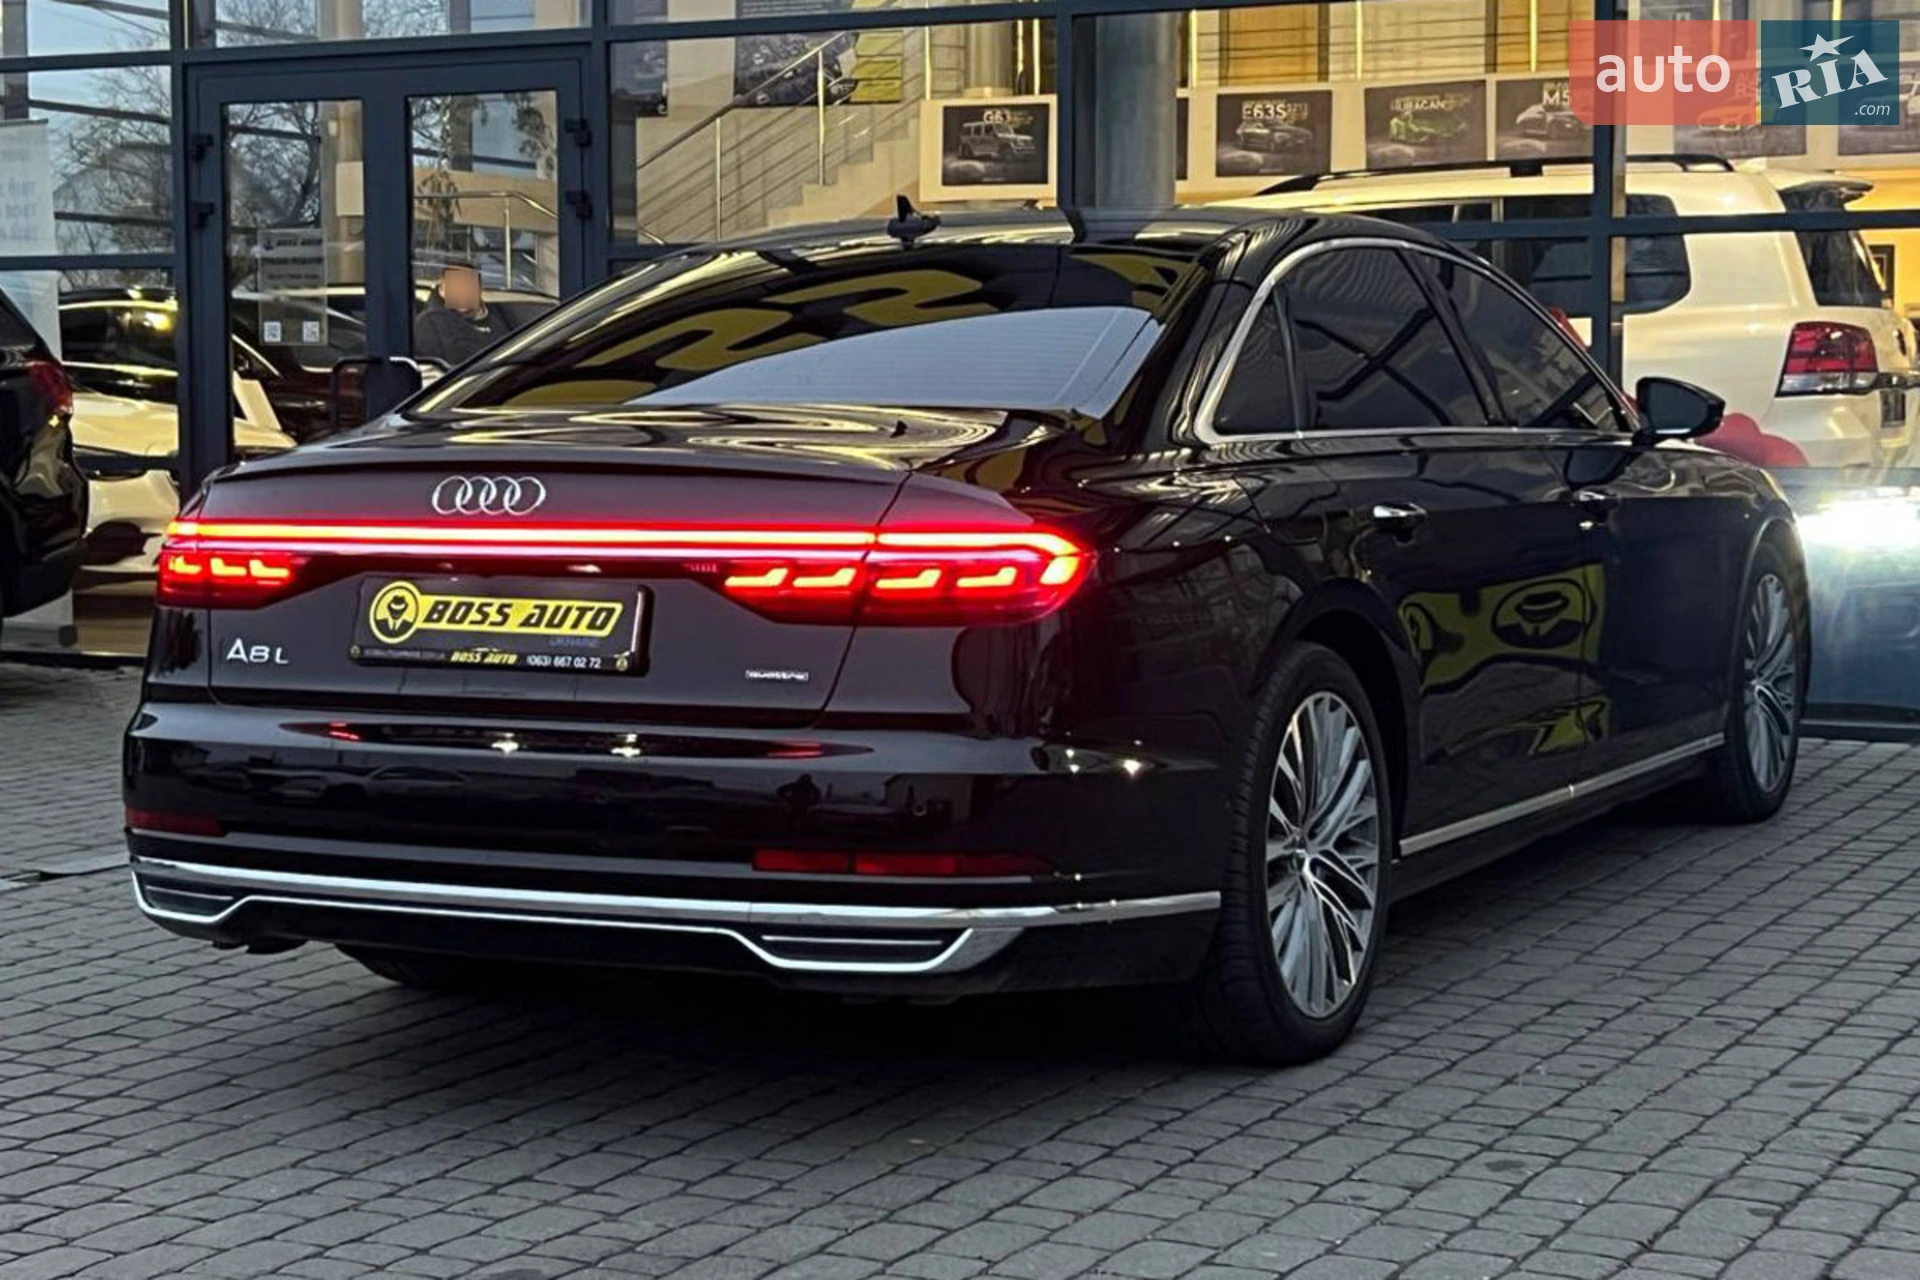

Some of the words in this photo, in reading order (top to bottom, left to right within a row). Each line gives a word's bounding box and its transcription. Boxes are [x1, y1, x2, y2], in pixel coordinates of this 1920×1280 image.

[983, 109, 1011, 124] G63
[1242, 103, 1287, 119] E63S
[423, 599, 514, 626] BOSS
[518, 603, 617, 631] AUTO
[450, 651, 483, 664] BOSS
[483, 652, 518, 666] AUTO
[572, 658, 587, 669] 02
[587, 658, 602, 670] 72
